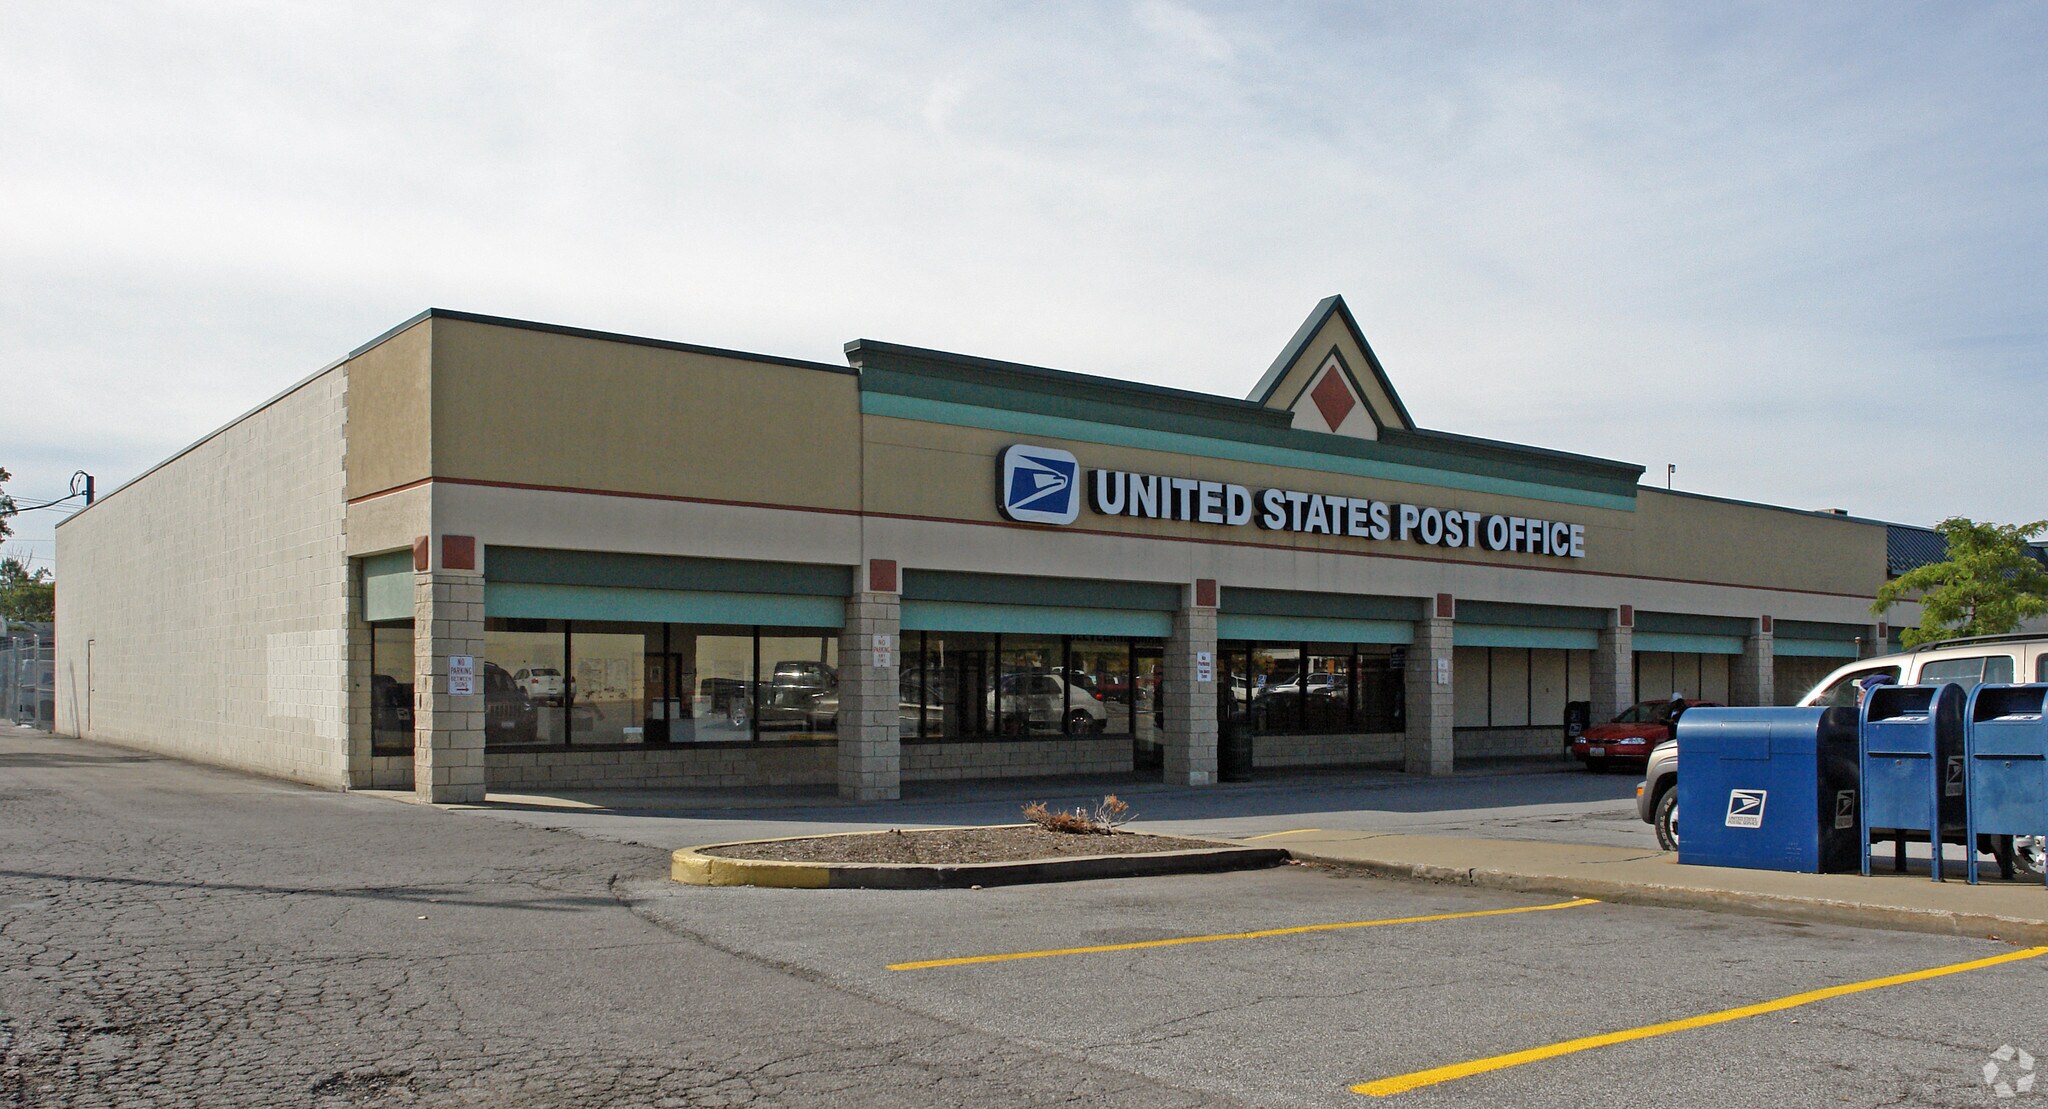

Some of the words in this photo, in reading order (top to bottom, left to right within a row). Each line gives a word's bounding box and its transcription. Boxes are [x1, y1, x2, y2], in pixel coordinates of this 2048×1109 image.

[1095, 469, 1253, 526] UNITED
[1262, 488, 1391, 541] STATES
[1399, 503, 1481, 548] POST
[1485, 514, 1586, 558] OFFICE
[457, 658, 465, 666] NO
[450, 666, 472, 675] PARKING
